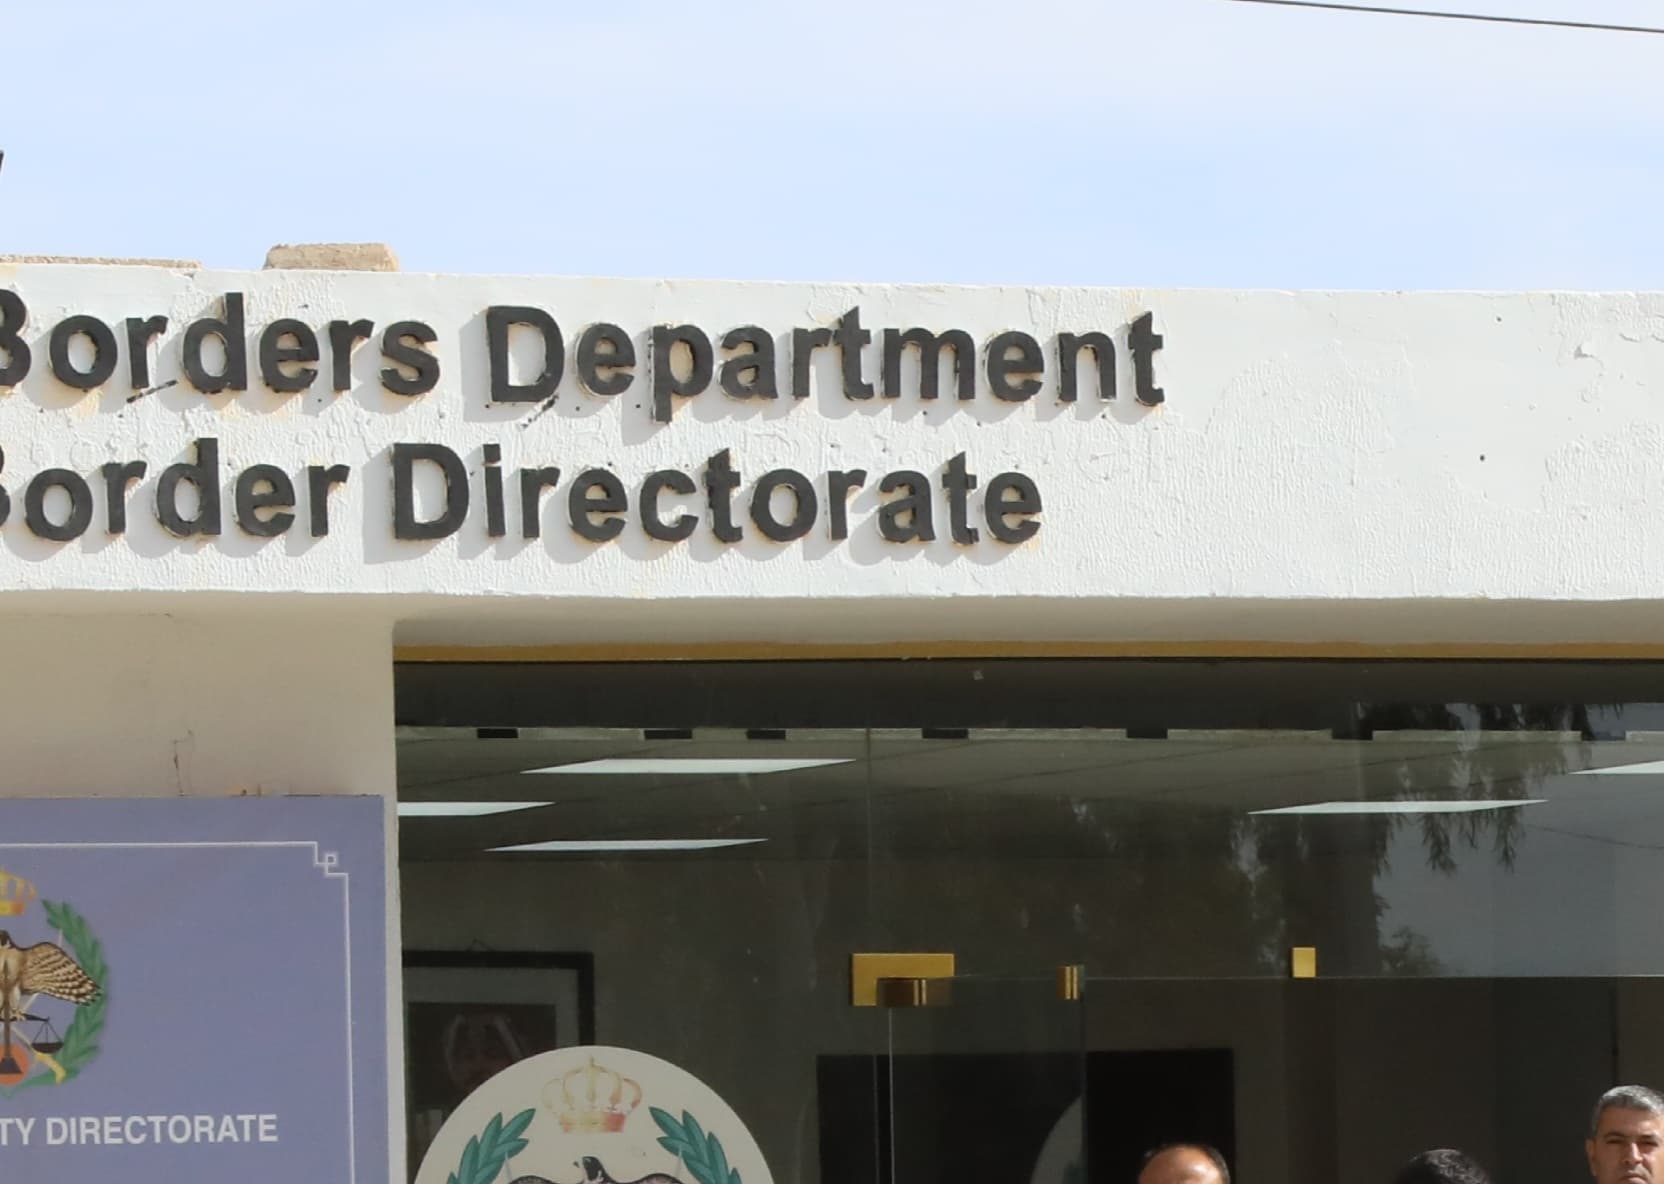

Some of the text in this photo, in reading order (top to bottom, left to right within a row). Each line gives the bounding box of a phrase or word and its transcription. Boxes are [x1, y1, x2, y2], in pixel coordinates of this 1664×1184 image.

[486, 307, 1164, 425] Department
[0, 437, 1042, 546] order Directorate
[46, 1113, 279, 1146] DIRECTORATE
